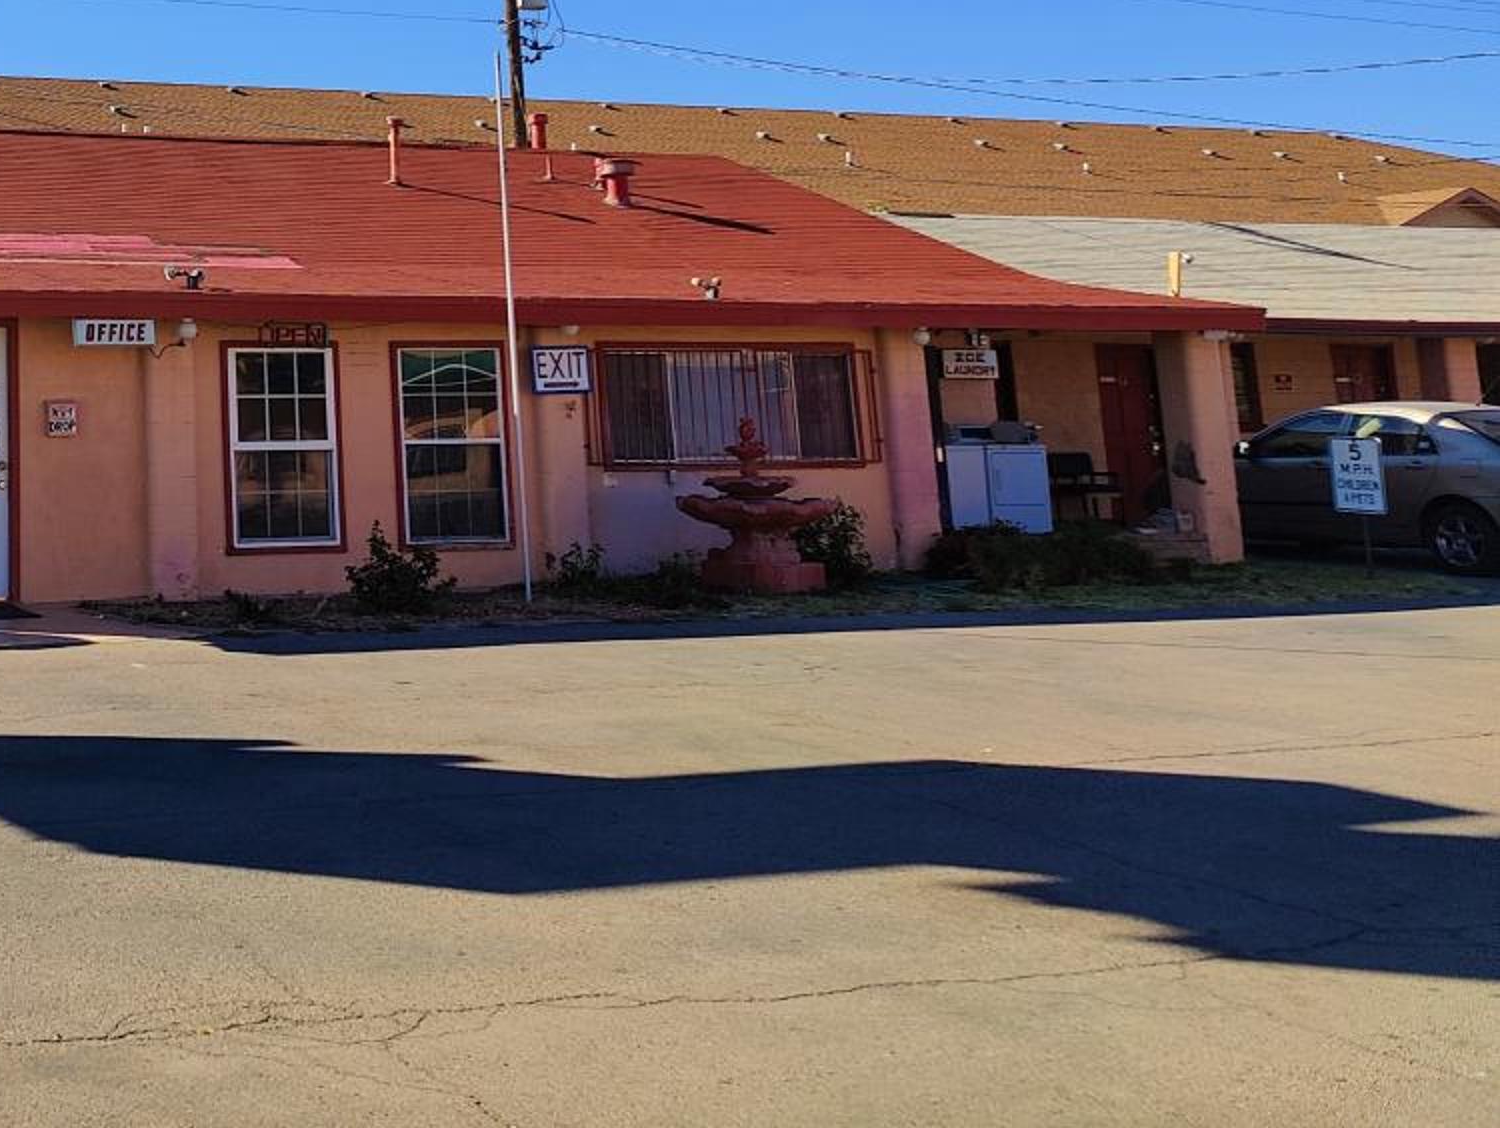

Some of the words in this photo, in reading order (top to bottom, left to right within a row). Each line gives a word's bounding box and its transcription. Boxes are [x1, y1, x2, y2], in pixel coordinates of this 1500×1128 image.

[85, 323, 146, 342] OFFICE
[259, 321, 326, 346] OPEN
[536, 352, 585, 378] EXIT
[1348, 443, 1362, 461] 5
